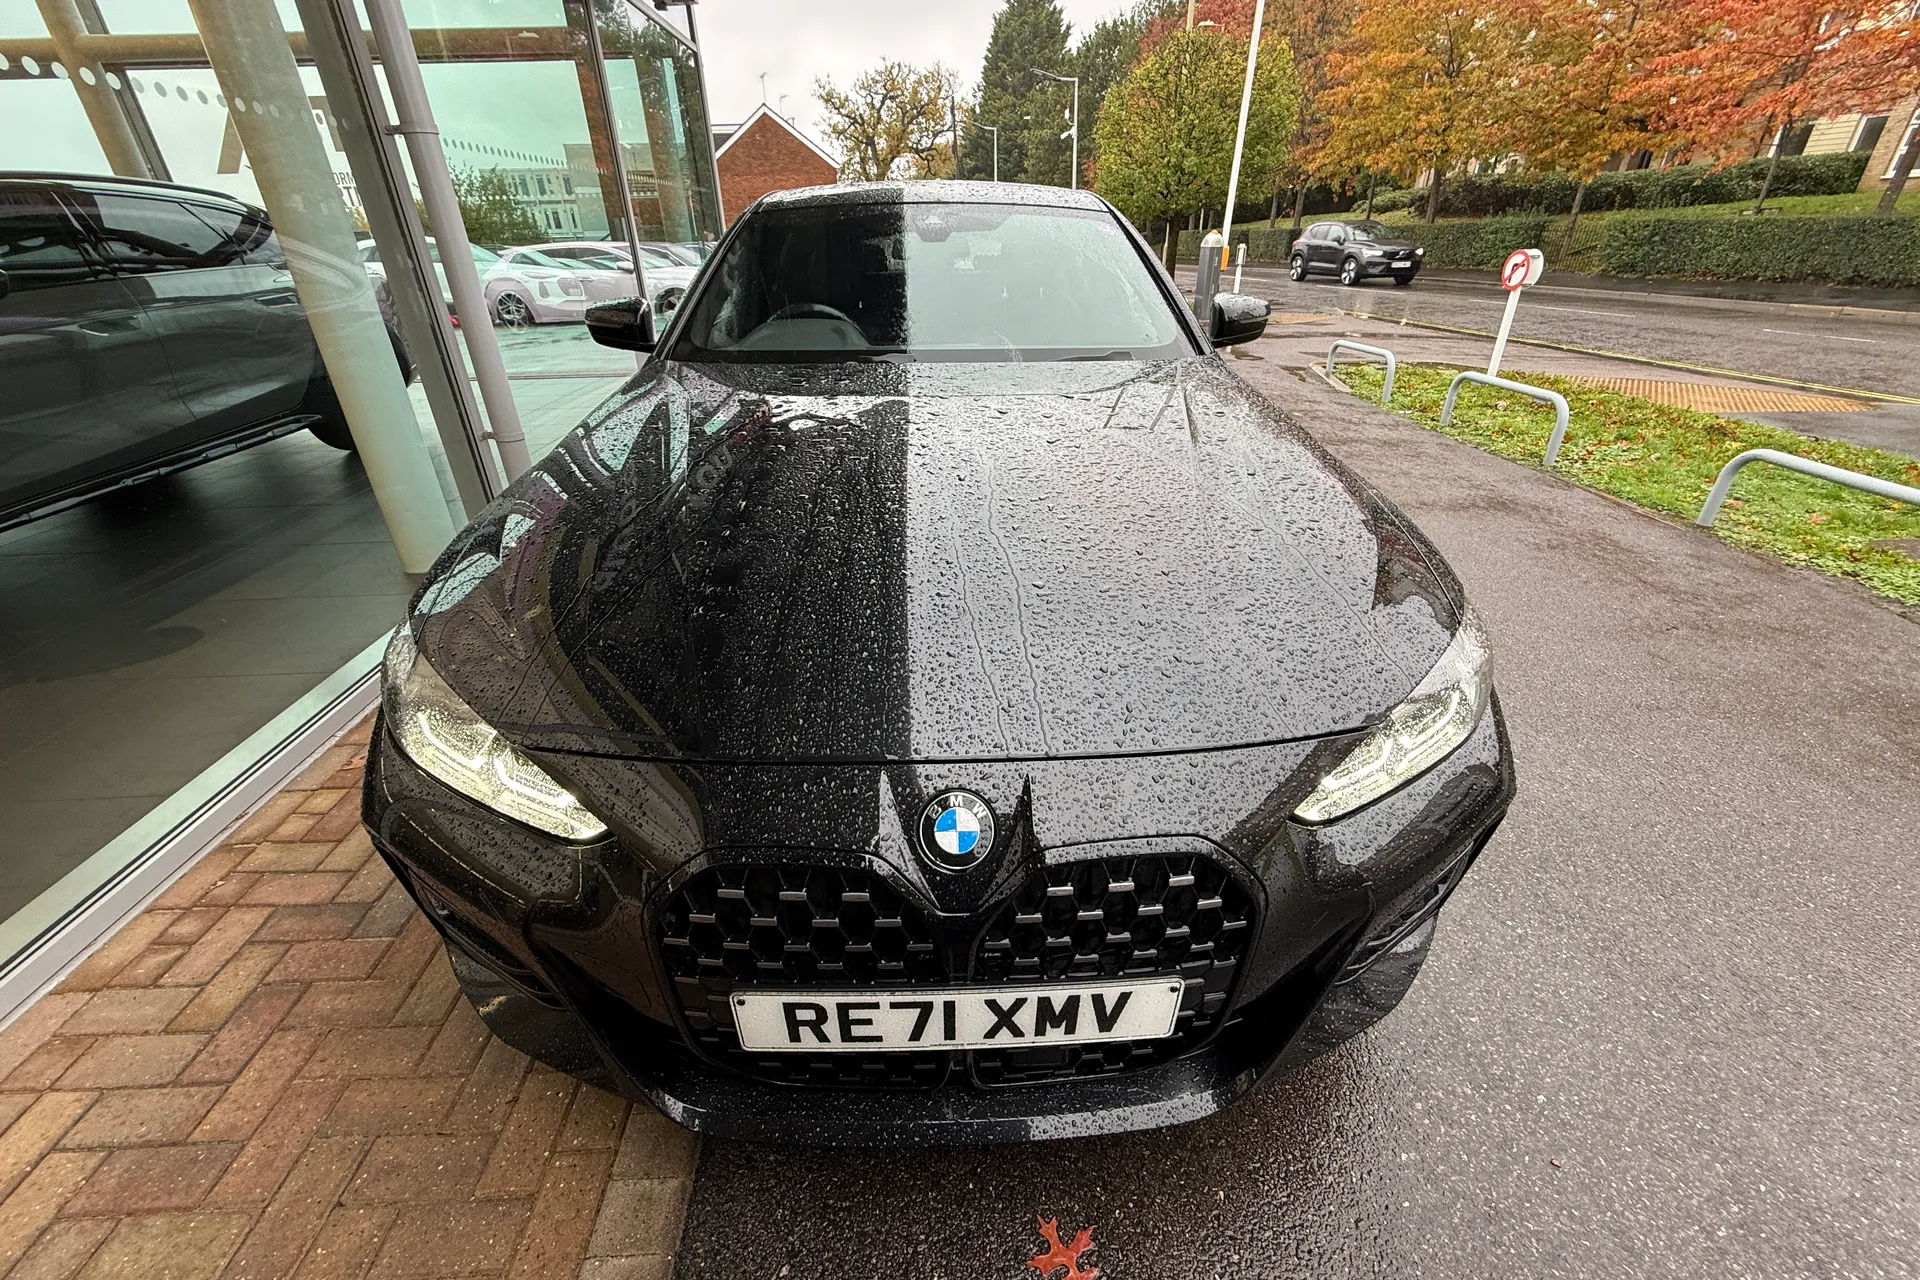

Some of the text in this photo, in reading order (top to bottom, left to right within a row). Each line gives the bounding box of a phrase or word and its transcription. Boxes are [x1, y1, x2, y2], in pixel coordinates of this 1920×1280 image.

[927, 795, 987, 820] BMW
[782, 991, 1134, 1043] RE71 XMV
